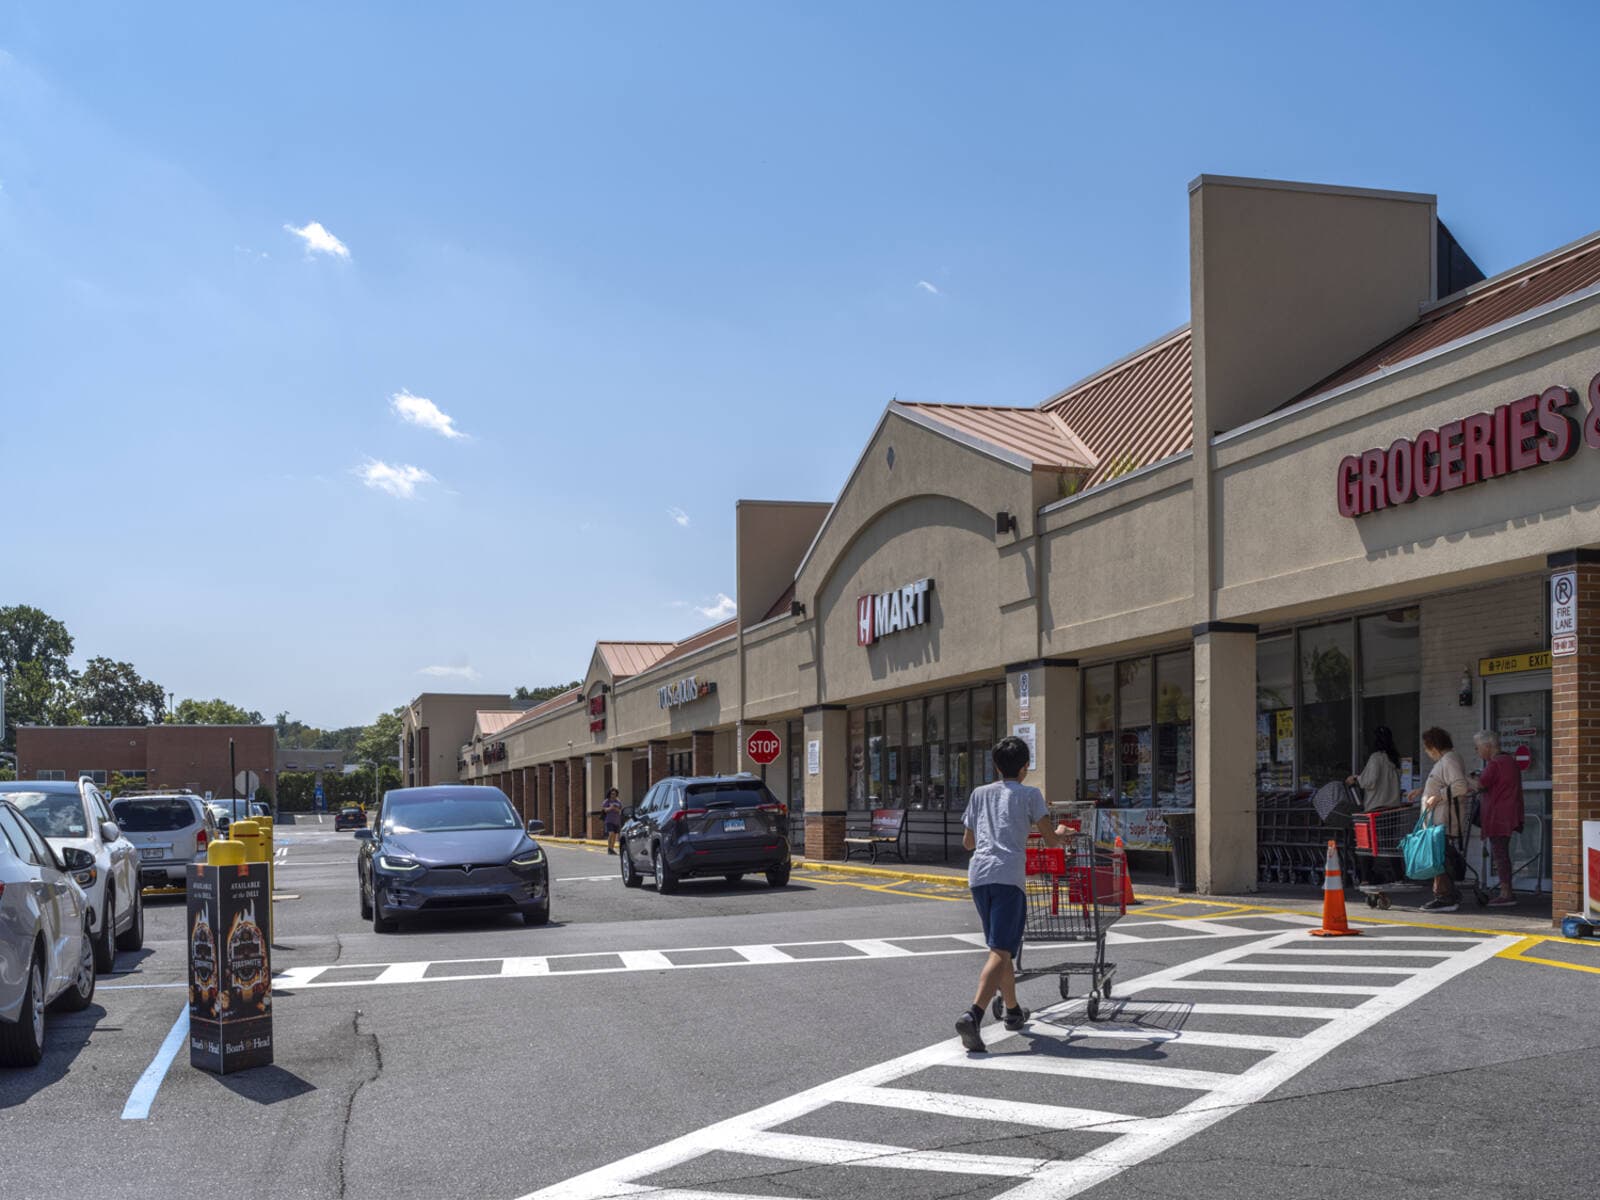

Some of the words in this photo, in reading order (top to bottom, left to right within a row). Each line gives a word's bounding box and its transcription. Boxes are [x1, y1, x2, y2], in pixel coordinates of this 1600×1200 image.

[1337, 385, 1580, 518] GROCERIES
[859, 594, 873, 645] H
[875, 578, 932, 638] MART
[1556, 606, 1571, 617] FIRE
[1555, 618, 1573, 630] LANE
[1529, 653, 1549, 667] EXIT
[749, 740, 778, 753] STOP
[231, 881, 260, 890] AVAILABLE
[246, 890, 259, 898] DELI
[253, 1036, 270, 1049] Head
